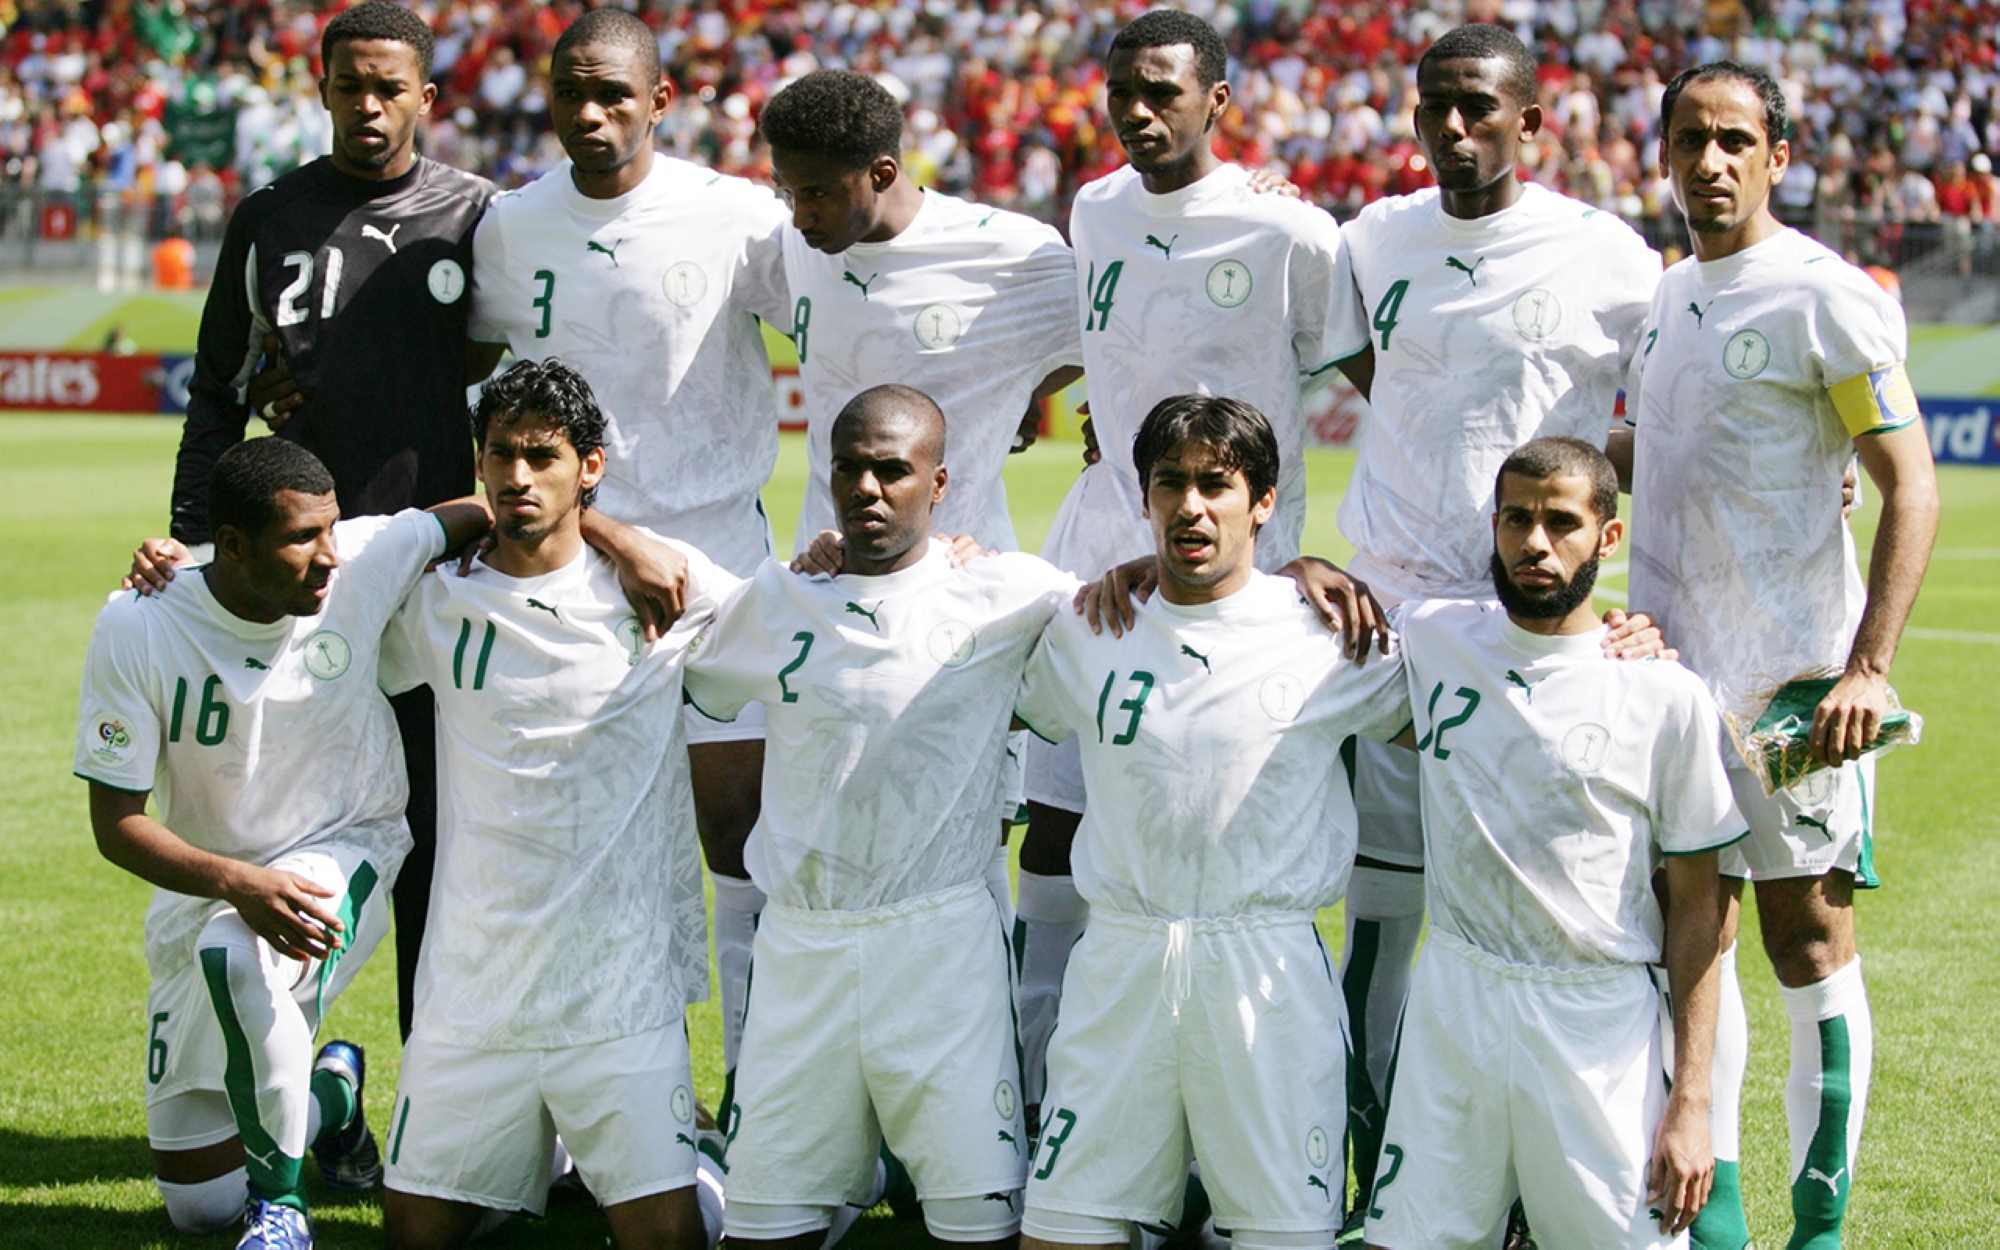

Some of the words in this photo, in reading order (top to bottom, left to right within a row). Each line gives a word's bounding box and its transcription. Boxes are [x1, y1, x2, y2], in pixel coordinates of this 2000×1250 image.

[277, 246, 344, 327] 21
[532, 269, 555, 338] 3
[1086, 260, 1124, 331] 14
[1373, 279, 1411, 351] 4
[794, 295, 811, 363] 8
[453, 619, 496, 691] 11
[778, 631, 815, 703] 2
[169, 674, 229, 746] 16
[1096, 670, 1155, 746] 13
[1417, 681, 1482, 761] 12
[148, 1011, 169, 1085] 6
[1369, 1143, 1404, 1220] 2
